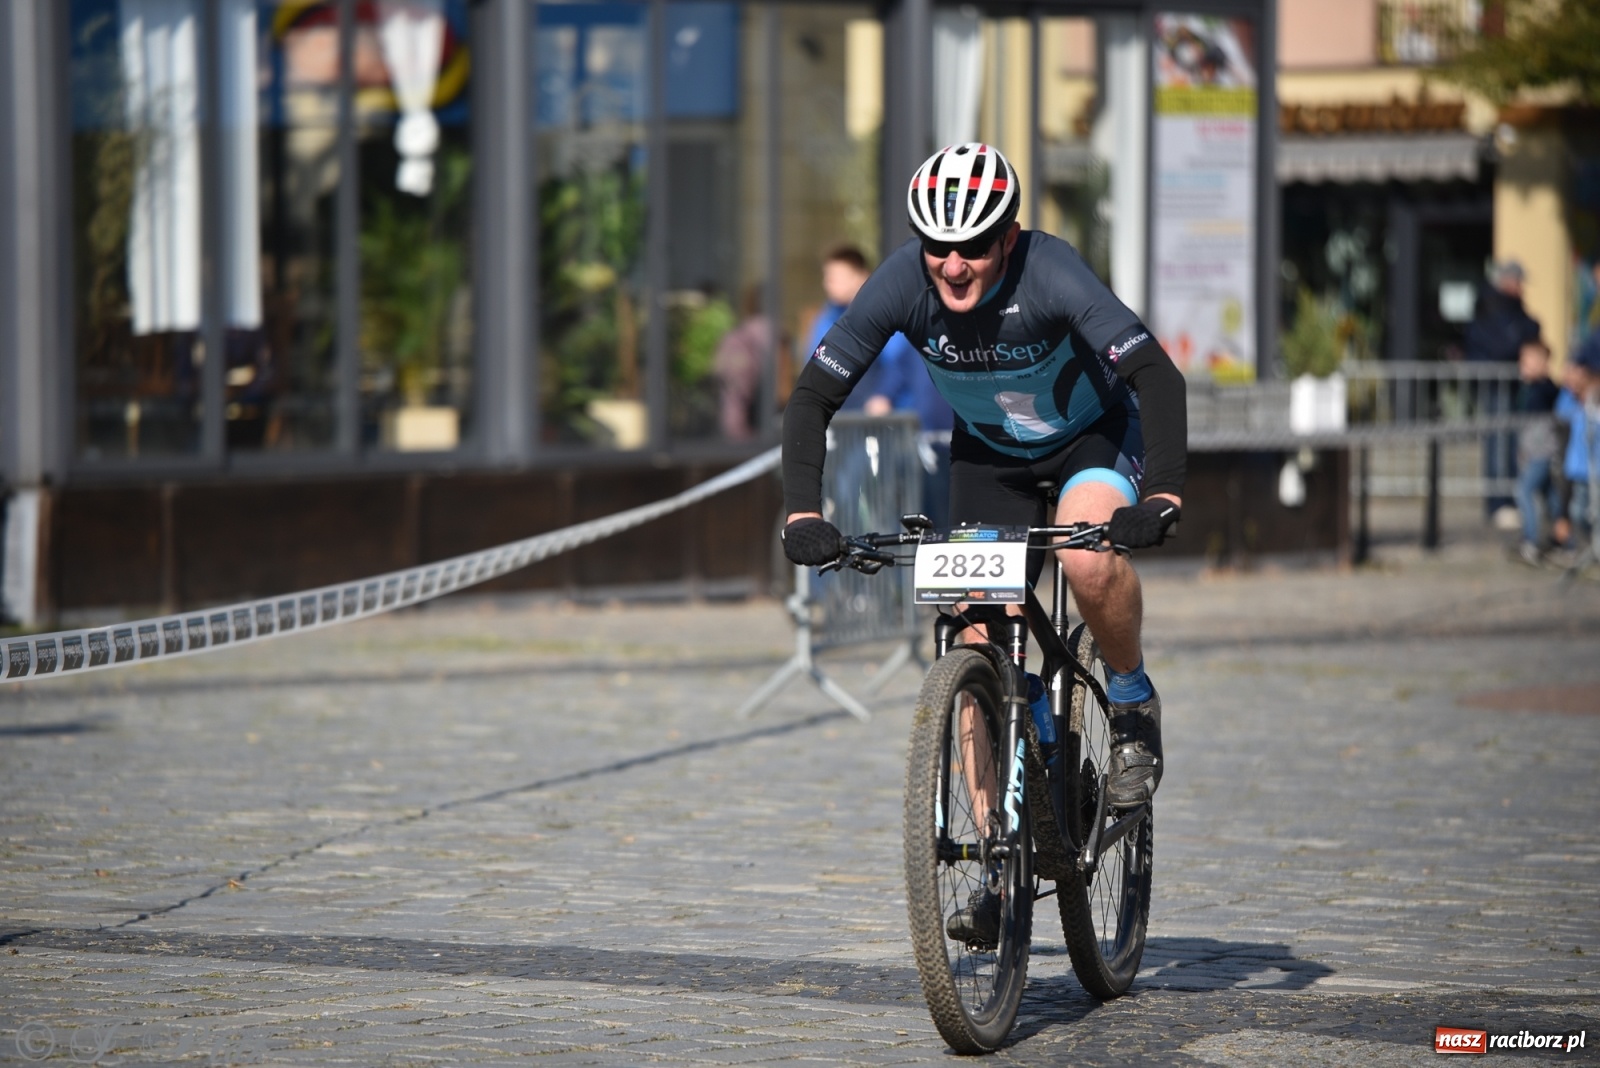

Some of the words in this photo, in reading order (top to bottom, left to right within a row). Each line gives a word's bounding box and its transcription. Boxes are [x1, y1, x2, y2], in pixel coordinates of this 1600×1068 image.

[944, 339, 1051, 363] SutriSept
[1115, 332, 1148, 357] Sutricon
[817, 350, 851, 378] Sutricon
[932, 554, 1005, 578] 2823
